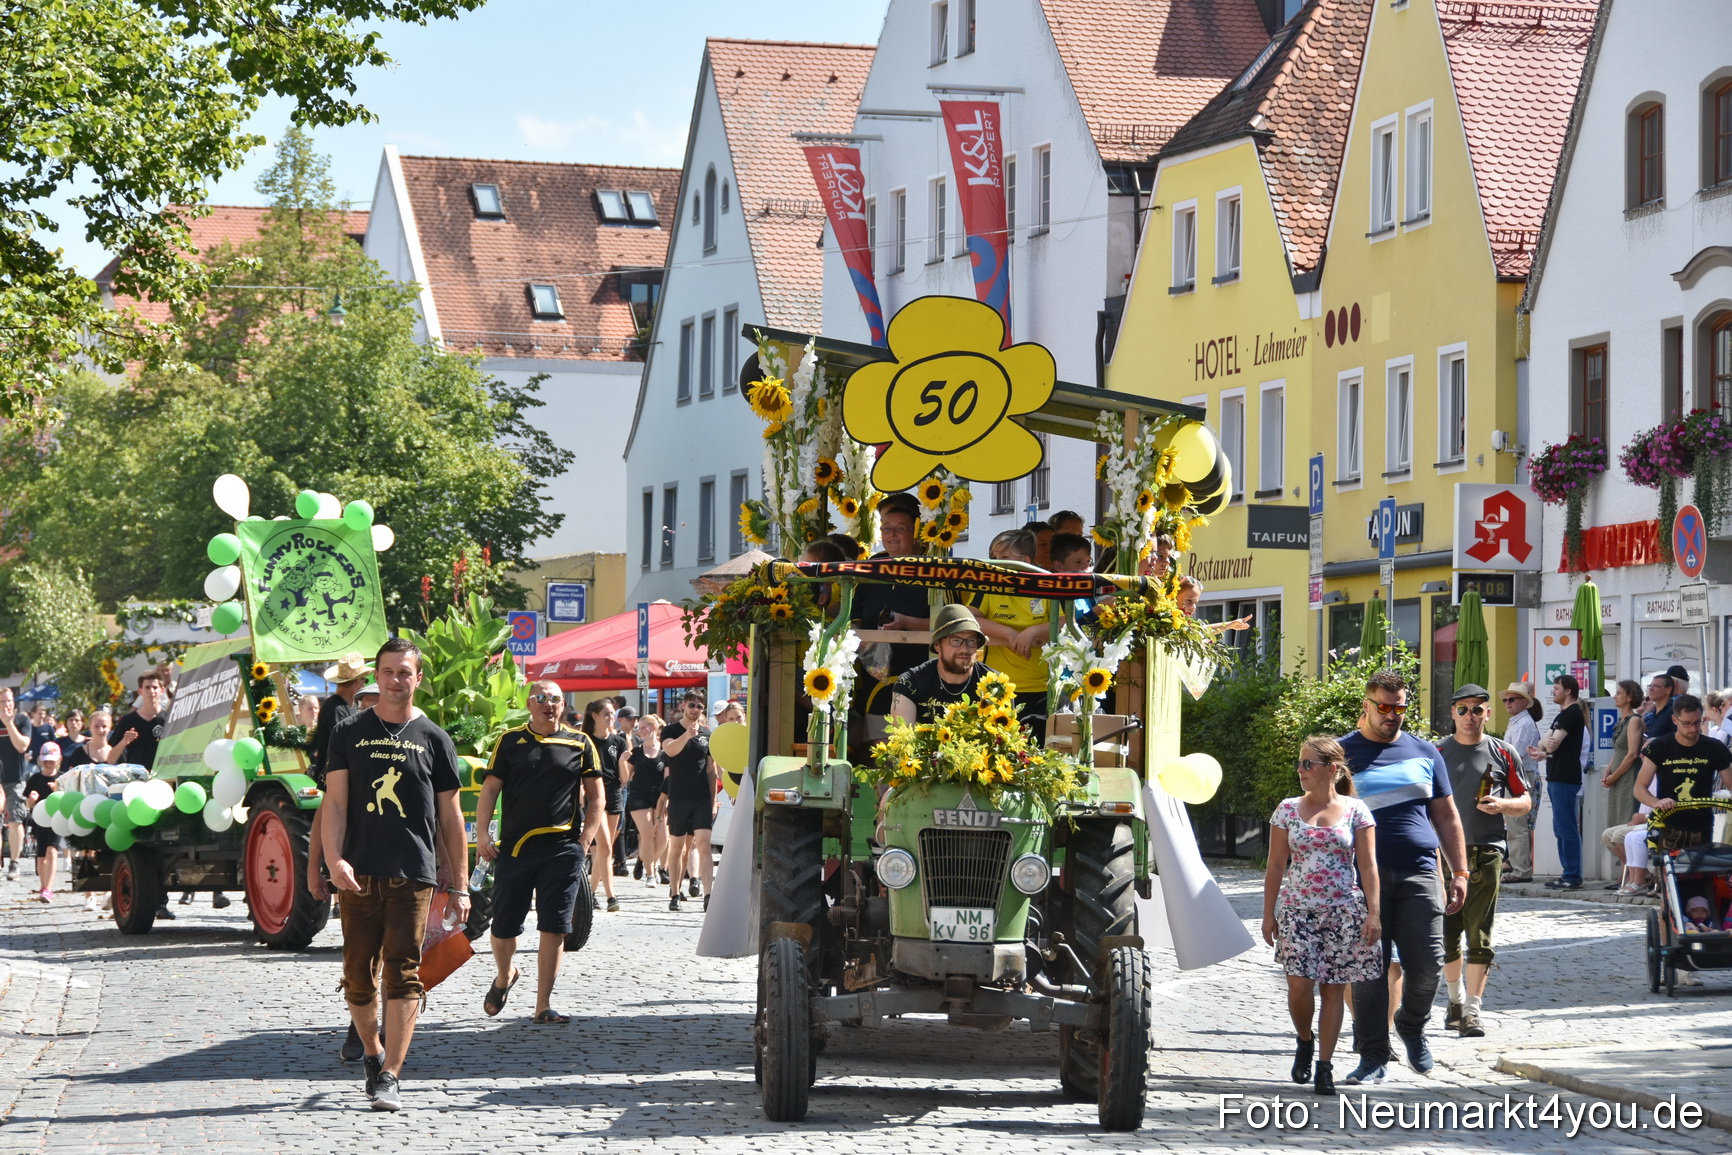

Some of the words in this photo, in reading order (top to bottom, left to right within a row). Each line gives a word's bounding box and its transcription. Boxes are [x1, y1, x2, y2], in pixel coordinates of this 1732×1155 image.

[955, 109, 994, 186] K&L
[1195, 335, 1241, 381] HOTEL
[1253, 327, 1307, 366] Lehmeier
[914, 380, 978, 426] 50
[1312, 464, 1320, 507] P
[1365, 510, 1411, 540] TAUN
[1382, 507, 1391, 552] P
[1252, 532, 1308, 544] TAIFUN
[893, 557, 957, 565] YOU'LL
[1188, 552, 1253, 581] Restaurant
[821, 562, 833, 573] 1.
[838, 563, 873, 573] FC
[879, 564, 1032, 586] NEUMARKT
[1037, 576, 1093, 590] SÜD
[895, 578, 946, 588] WALK
[955, 583, 1016, 594] ALONE
[1647, 600, 1674, 614] RATHAUS
[639, 616, 647, 639] P
[510, 642, 534, 653] TAXI
[1602, 714, 1614, 733] P
[355, 738, 369, 748] An
[402, 740, 425, 754] Story
[370, 750, 390, 760] since
[391, 752, 407, 762] 1969
[933, 810, 1002, 826] FENDT
[956, 910, 982, 925] NM
[934, 924, 956, 938] KV
[969, 926, 989, 940] 96
